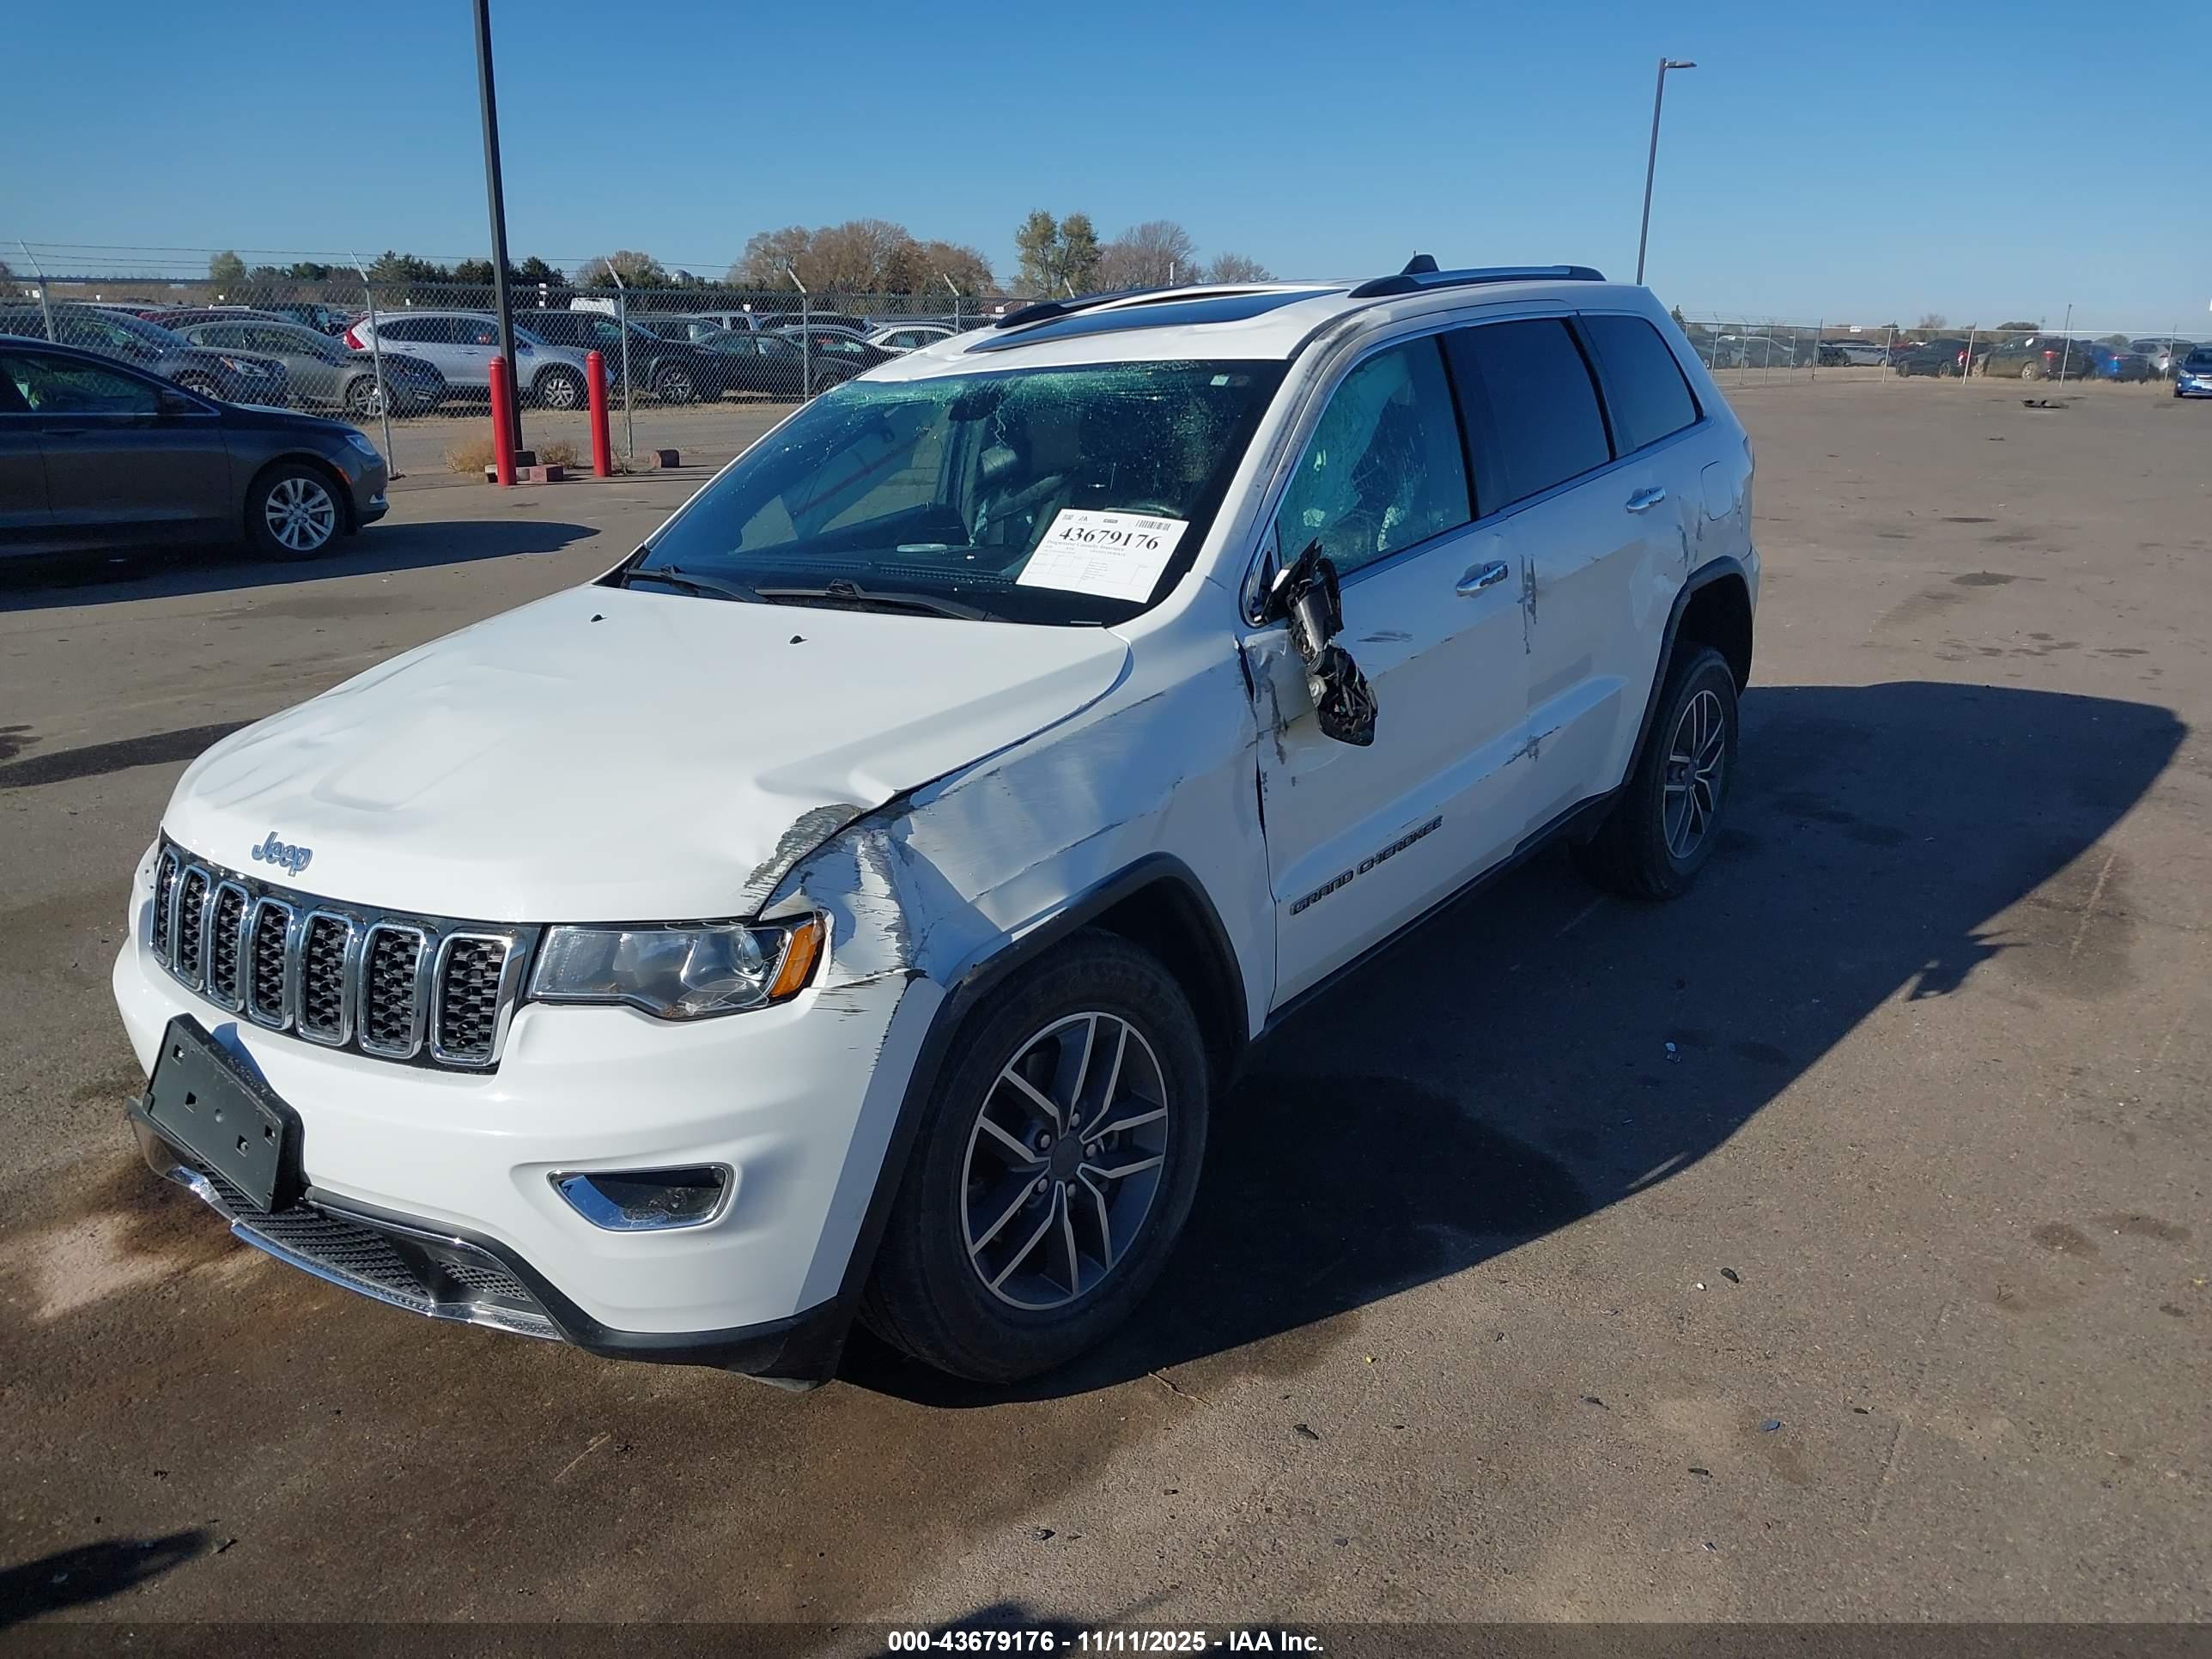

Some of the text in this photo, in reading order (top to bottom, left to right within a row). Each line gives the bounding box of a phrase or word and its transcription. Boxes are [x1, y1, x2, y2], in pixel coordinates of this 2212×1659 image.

[1059, 526, 1162, 550] 43679176
[251, 830, 313, 878] Jeep
[1290, 815, 1443, 915] GRAND CHEROKEE
